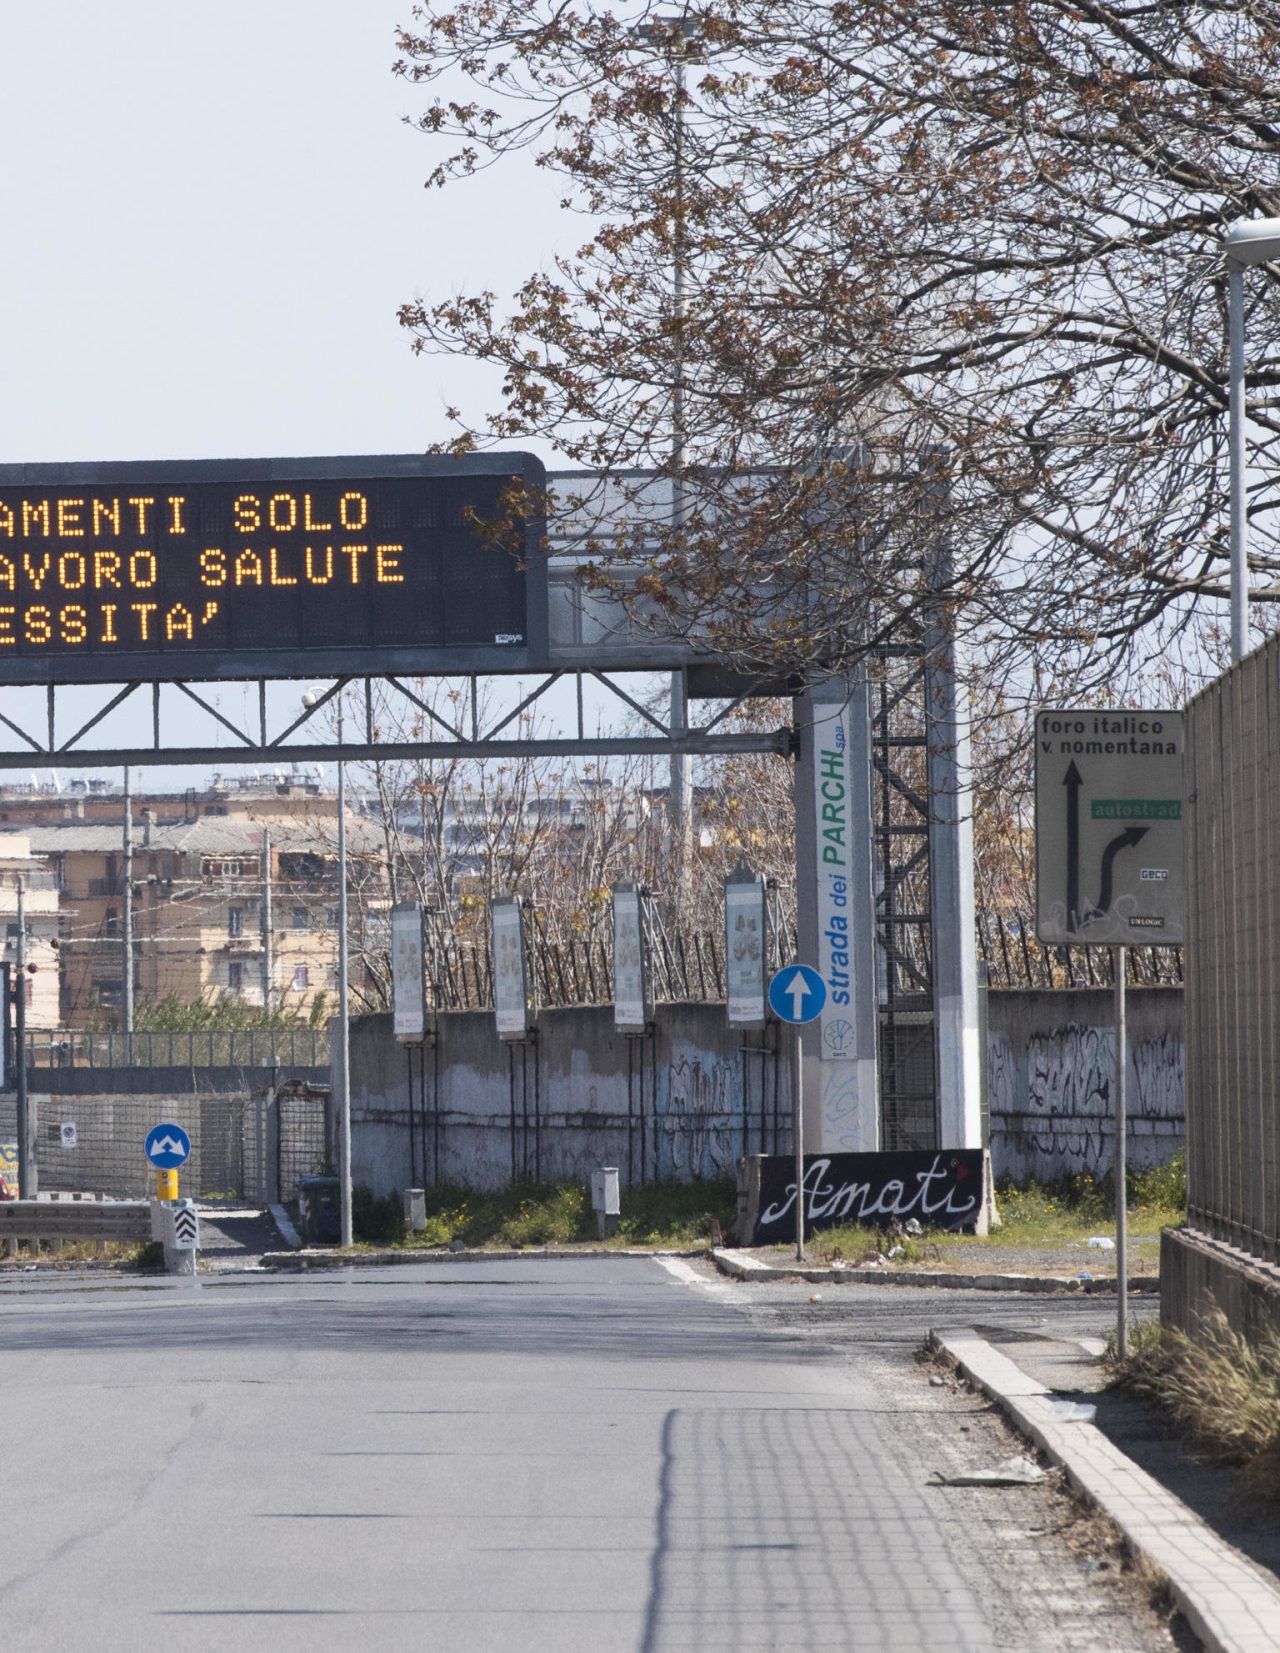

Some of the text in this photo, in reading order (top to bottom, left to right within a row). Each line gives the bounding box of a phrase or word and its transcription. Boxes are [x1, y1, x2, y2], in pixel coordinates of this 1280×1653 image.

[233, 492, 368, 533] SOLO
[199, 544, 405, 588] SALUTE
[1041, 717, 1163, 735] foro italico
[1041, 737, 1176, 755] v. nomentana
[1095, 802, 1182, 818] autostrad
[820, 725, 850, 1005] strada dei PARCHI spa
[760, 1154, 976, 1226] Amati
